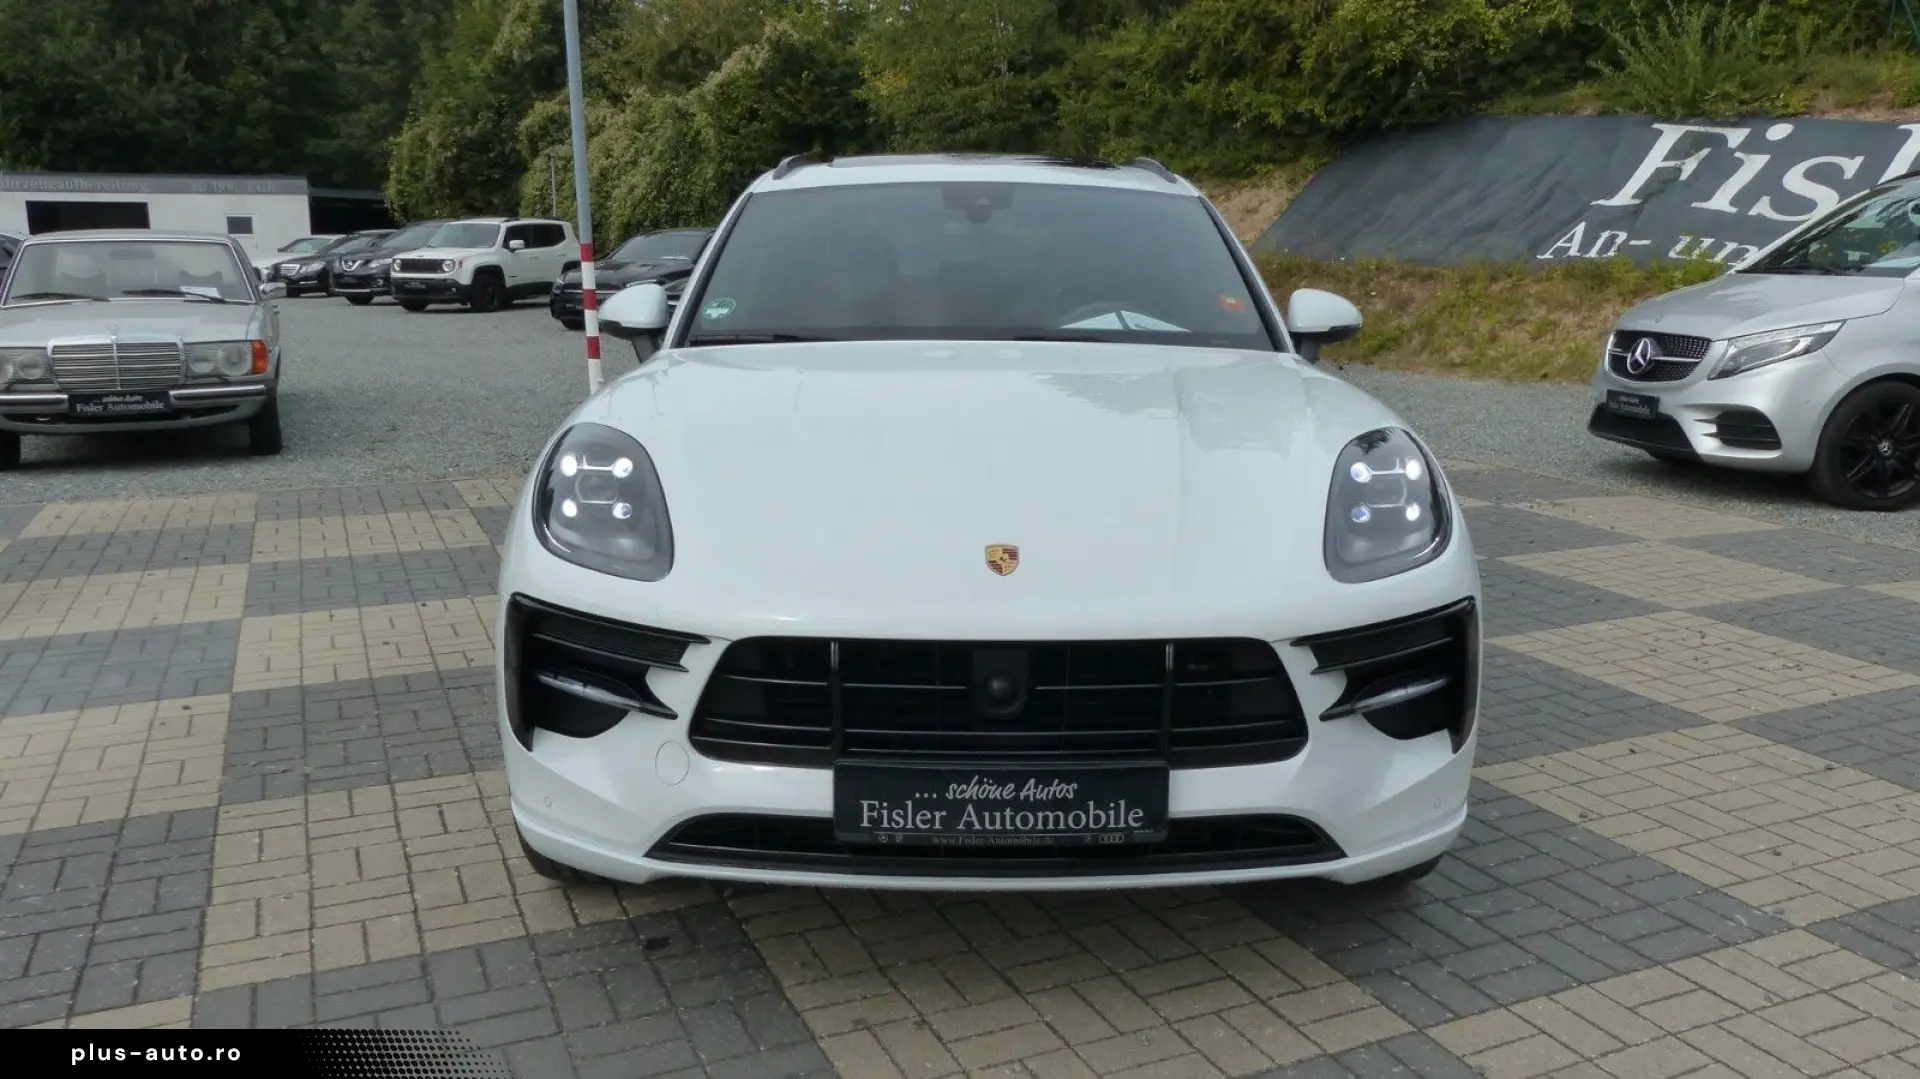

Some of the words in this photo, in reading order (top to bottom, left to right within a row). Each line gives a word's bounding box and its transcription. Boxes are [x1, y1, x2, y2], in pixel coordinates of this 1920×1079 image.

[1536, 221, 1652, 258] An-
[107, 400, 164, 411] Automobile
[945, 775, 1016, 800] schöne
[1019, 778, 1078, 801] Autos
[860, 800, 947, 829] Fisler
[956, 799, 1144, 830] Automobile
